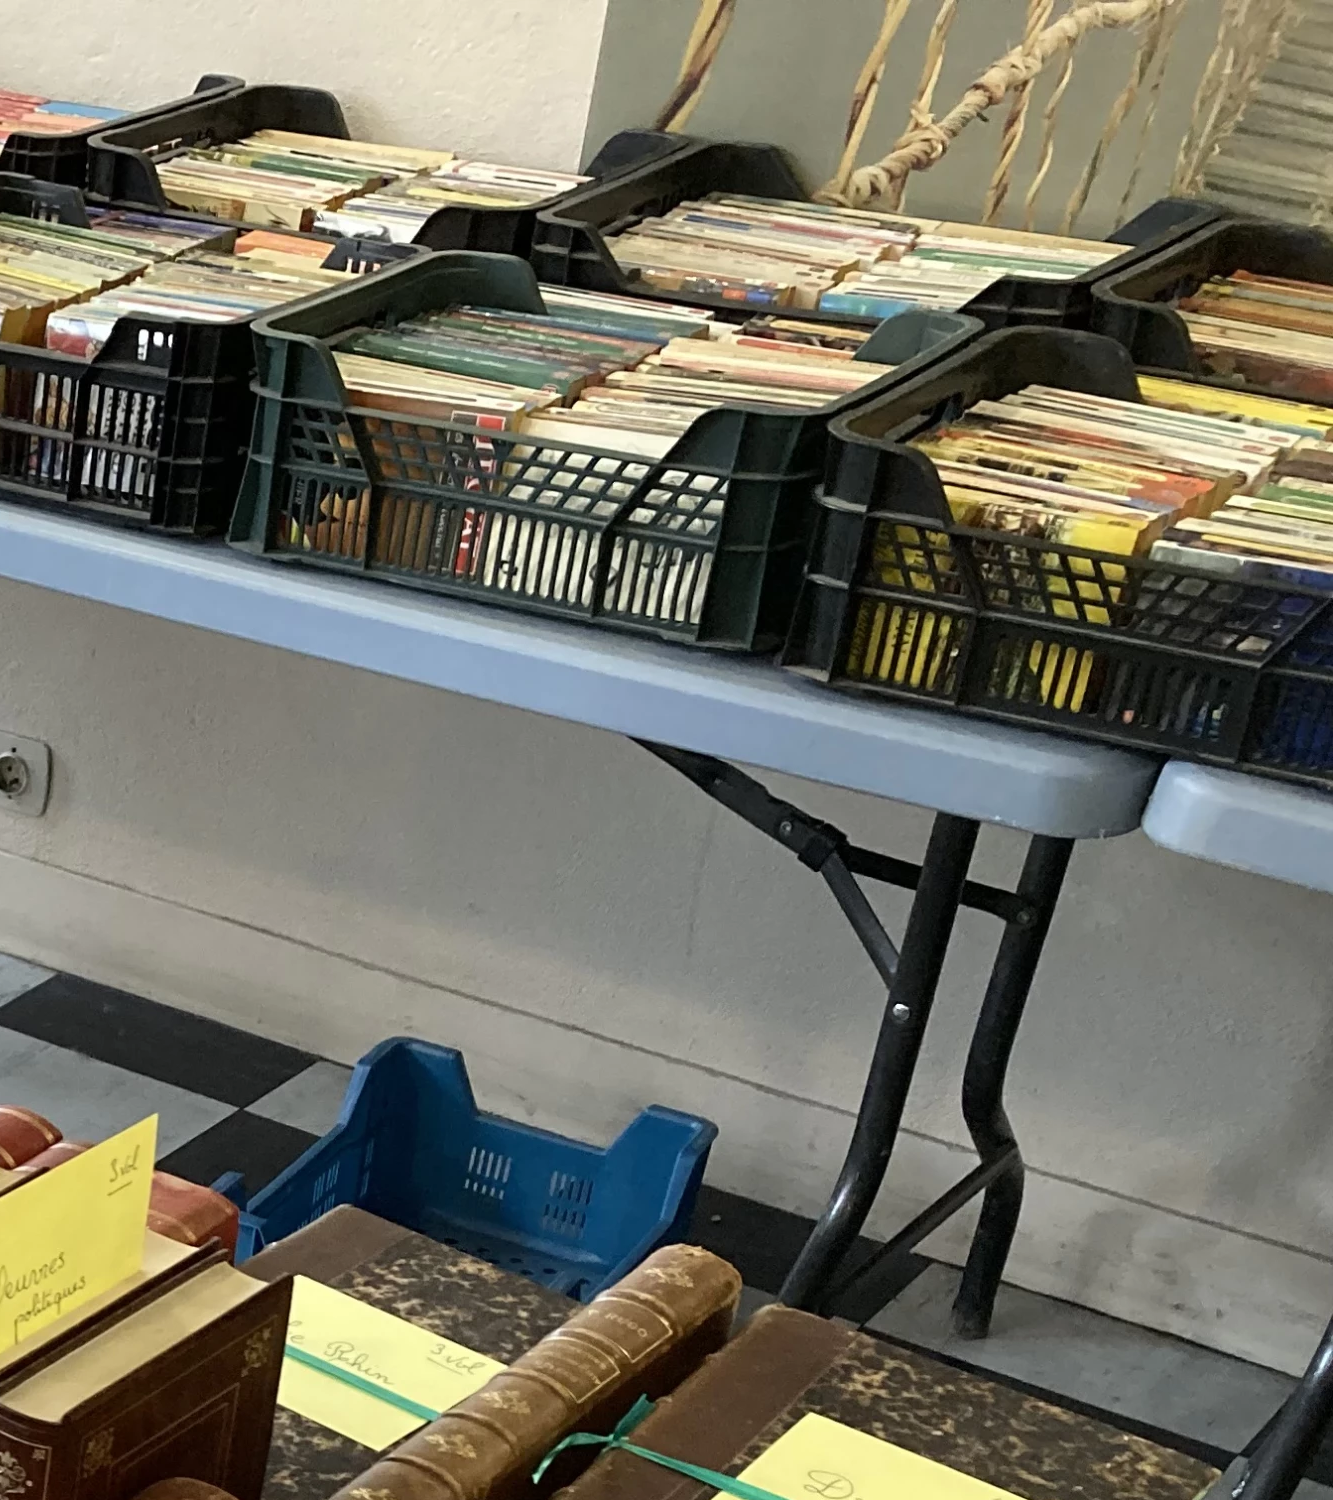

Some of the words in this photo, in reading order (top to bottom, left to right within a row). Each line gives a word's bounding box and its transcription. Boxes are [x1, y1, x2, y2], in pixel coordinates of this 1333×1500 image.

[119, 1145, 141, 1180] vol
[12, 1271, 89, 1344] politiques
[322, 1339, 397, 1387] Rhin
[429, 1342, 442, 1357] 3
[445, 1353, 488, 1376] vol
